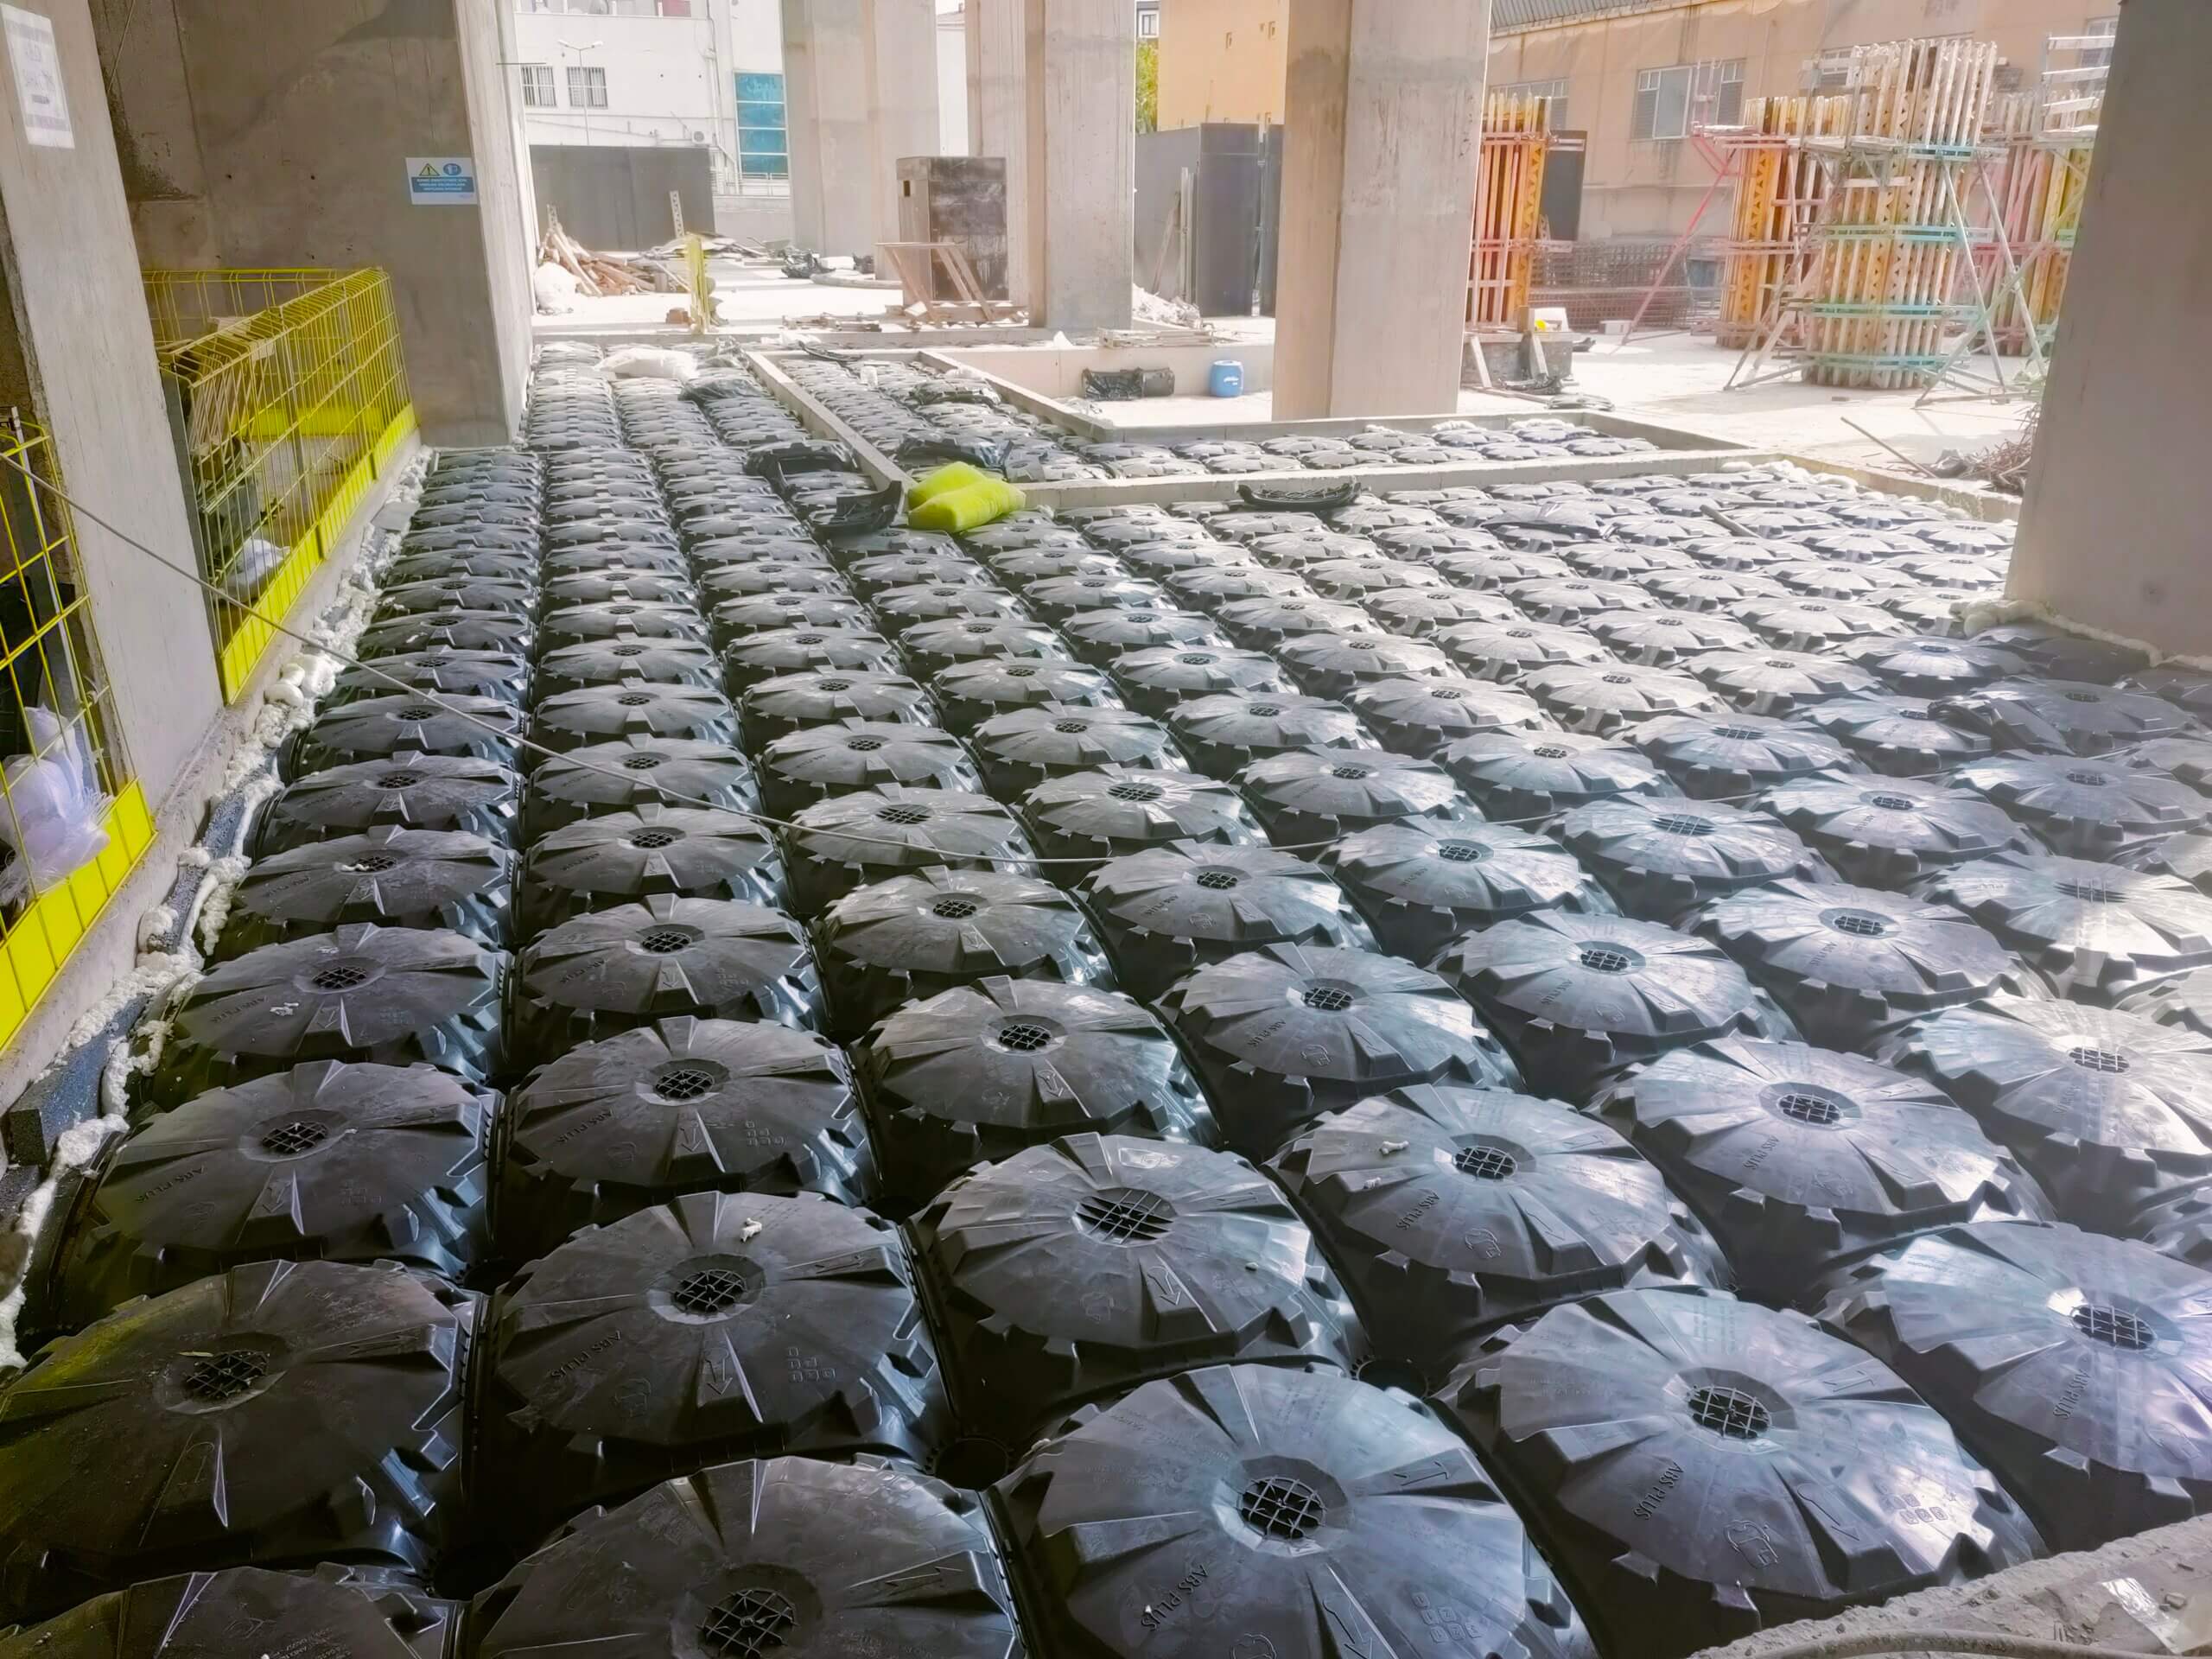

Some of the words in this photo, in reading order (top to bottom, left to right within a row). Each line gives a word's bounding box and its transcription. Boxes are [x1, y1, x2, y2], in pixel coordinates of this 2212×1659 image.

[588, 1105, 617, 1127] ABS
[555, 1122, 588, 1145] PLUS
[1742, 1147, 1768, 1171] PLUS
[135, 1180, 174, 1204] PLUS
[1418, 1190, 1441, 1210] ABS
[1395, 1207, 1424, 1230] PLUS
[591, 1328, 622, 1354] ABS
[549, 1348, 593, 1380] PLUS
[2069, 1368, 2092, 1391] ABS
[2052, 1389, 2081, 1421] PLUS
[1659, 1461, 1684, 1489] ABS
[1632, 1485, 1666, 1521] PLUS
[1178, 1564, 1209, 1595] ABS
[1141, 1590, 1183, 1631] PLUS
